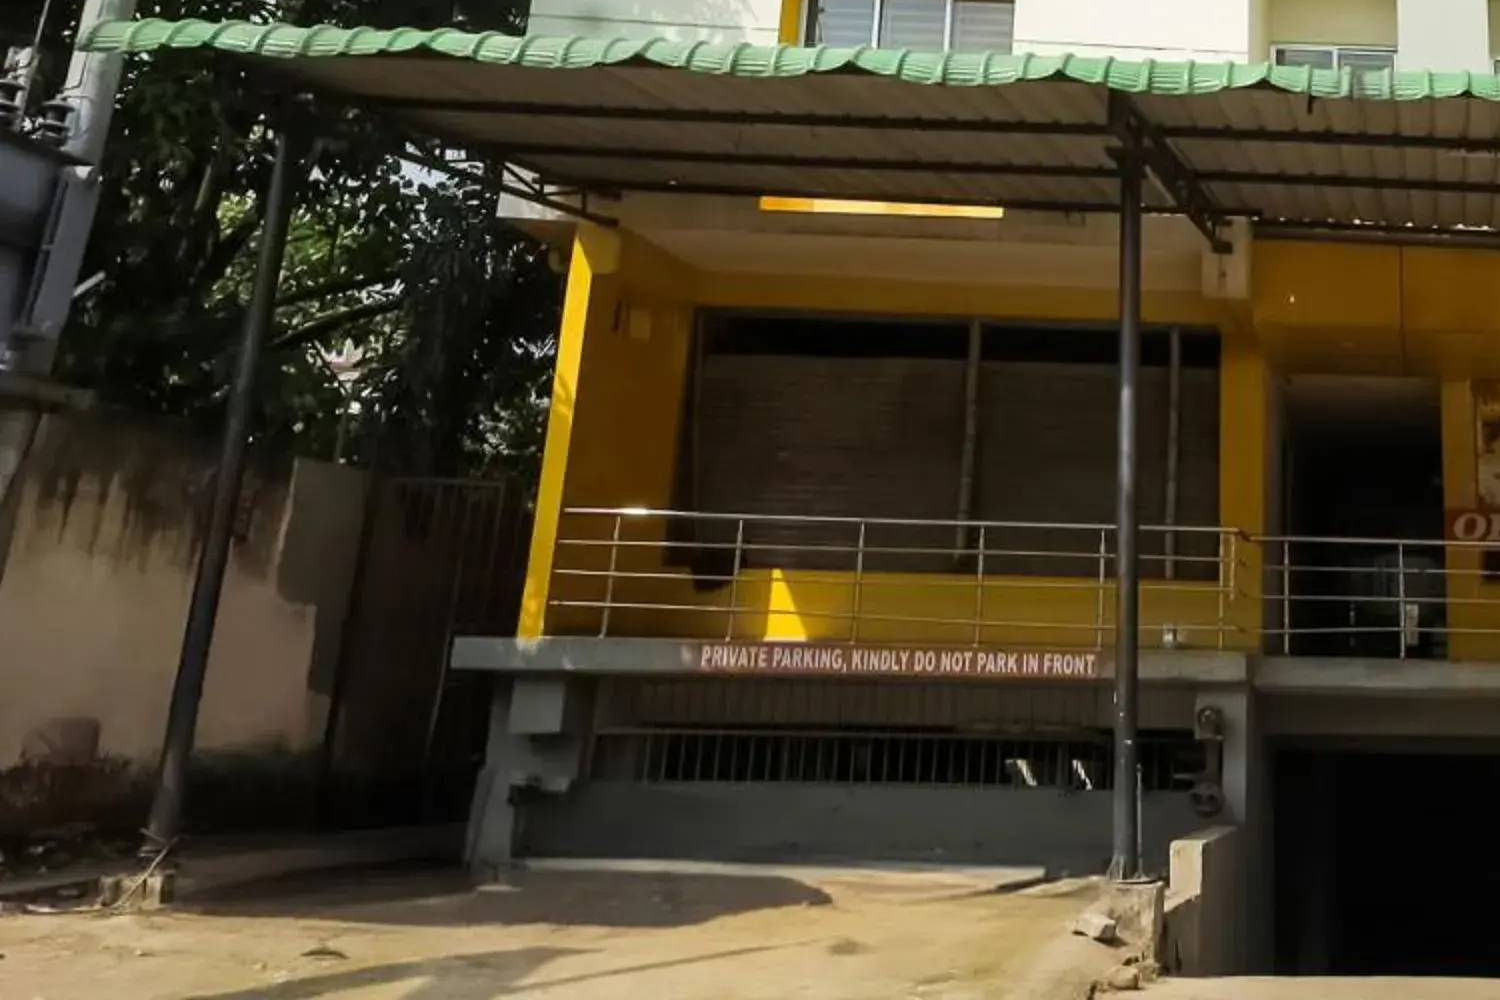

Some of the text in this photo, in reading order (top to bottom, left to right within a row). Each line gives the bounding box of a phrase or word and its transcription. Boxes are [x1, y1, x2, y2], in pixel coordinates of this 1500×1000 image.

[701, 645, 1096, 675] PRIVATE PARKING, KINDLY DO NOT PARK IN FRONT
